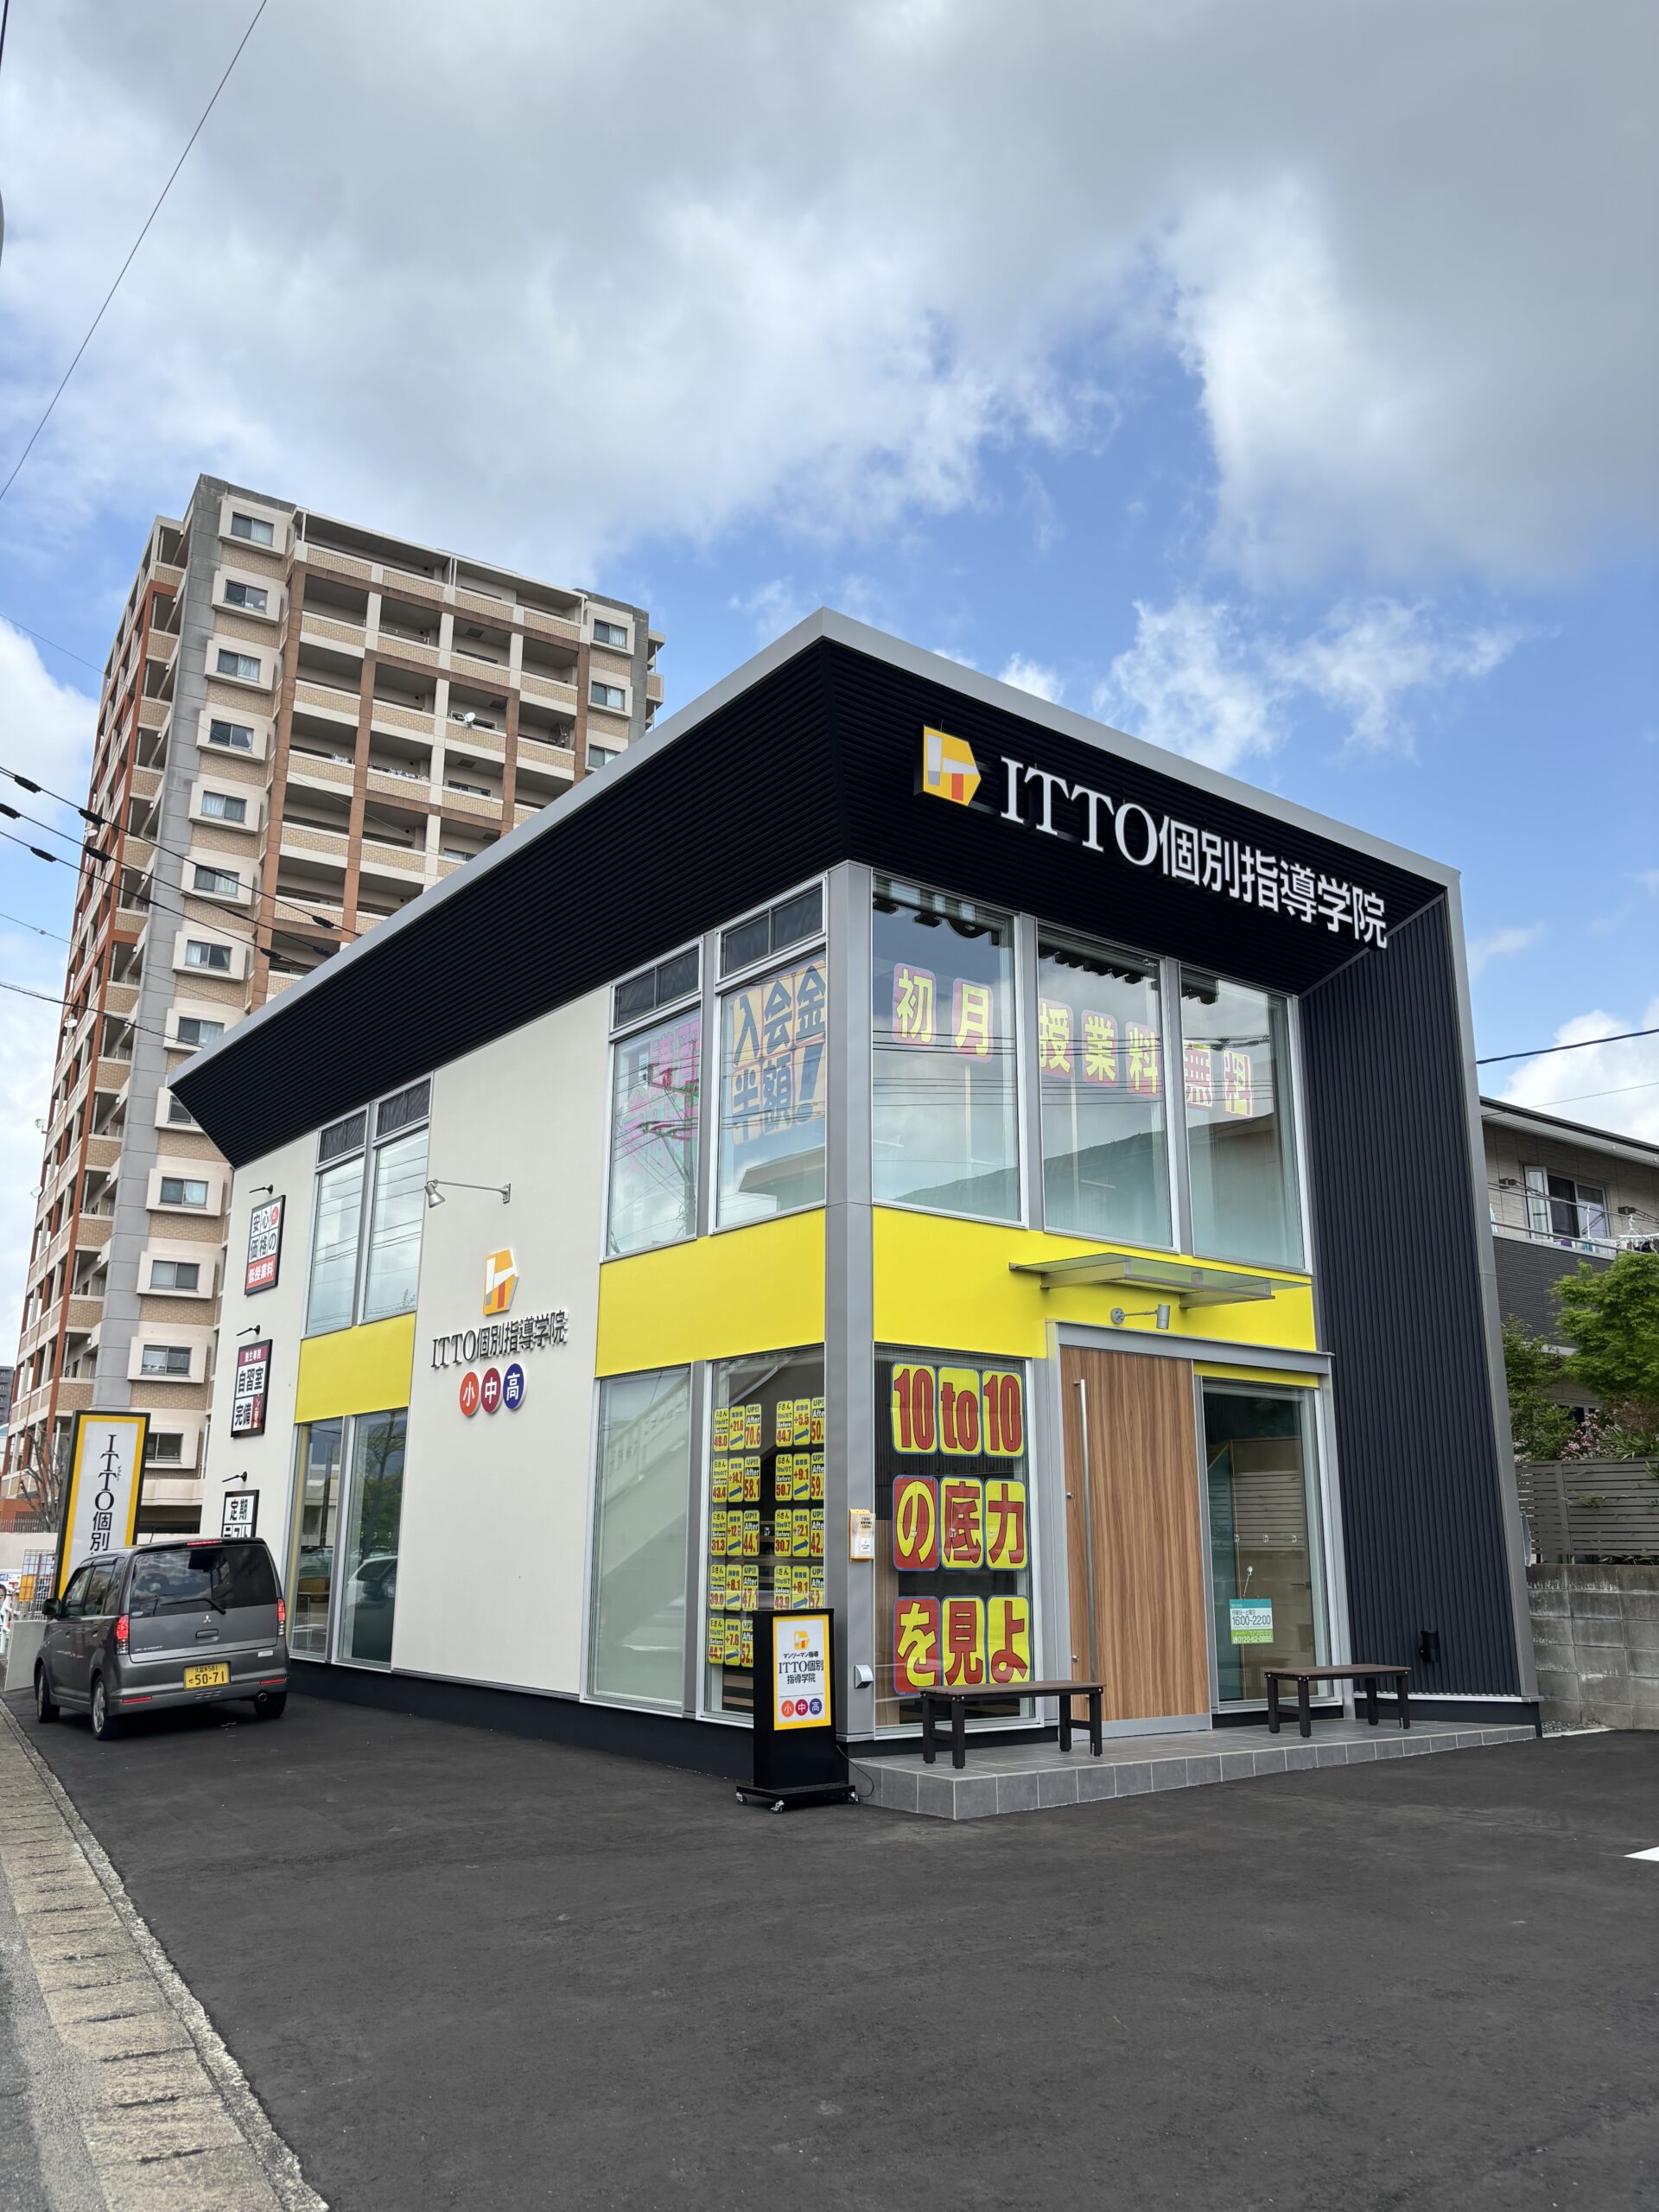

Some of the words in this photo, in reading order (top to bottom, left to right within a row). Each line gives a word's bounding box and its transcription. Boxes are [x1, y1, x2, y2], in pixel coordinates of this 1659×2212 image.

[1000, 754, 1388, 950] ITTO個別指導学院
[734, 965, 826, 1068] 入会金
[431, 1310, 567, 1368] ITTO個別指導学院
[238, 1366, 264, 1393] 自習室
[234, 1403, 252, 1426] 完備
[746, 1427, 760, 1446] 70.6
[778, 1430, 791, 1441] 44.7
[811, 1421, 823, 1440] 50.
[715, 1435, 728, 1446] 49.0
[812, 1465, 825, 1473] Afte
[90, 1434, 119, 1553] ITTO個別
[713, 1487, 726, 1498] 43.4
[745, 1478, 760, 1498] 58.1
[777, 1484, 791, 1496] 50.7
[811, 1476, 823, 1497] 59.
[229, 1498, 249, 1521] 定期
[896, 1479, 1026, 1566] の底力
[712, 1539, 725, 1551] 31.3
[744, 1533, 759, 1552] 44.1
[776, 1540, 790, 1551] 30.7
[811, 1533, 823, 1553] 42.
[812, 1579, 824, 1587] Afte
[710, 1593, 723, 1605] 39.0
[743, 1589, 759, 1608] 47.1
[775, 1596, 789, 1608] 43.9
[810, 1590, 823, 1608] 52.
[1232, 1615, 1271, 1625] 16:00-22:00
[743, 1632, 753, 1641] Afte
[897, 1600, 1028, 1687] を見よ
[709, 1647, 722, 1659] 44.7
[741, 1643, 753, 1662] 52.
[779, 1659, 824, 1674] ITTO個別
[195, 1670, 225, 1685] 50-71
[787, 1673, 816, 1684] 指導学院
